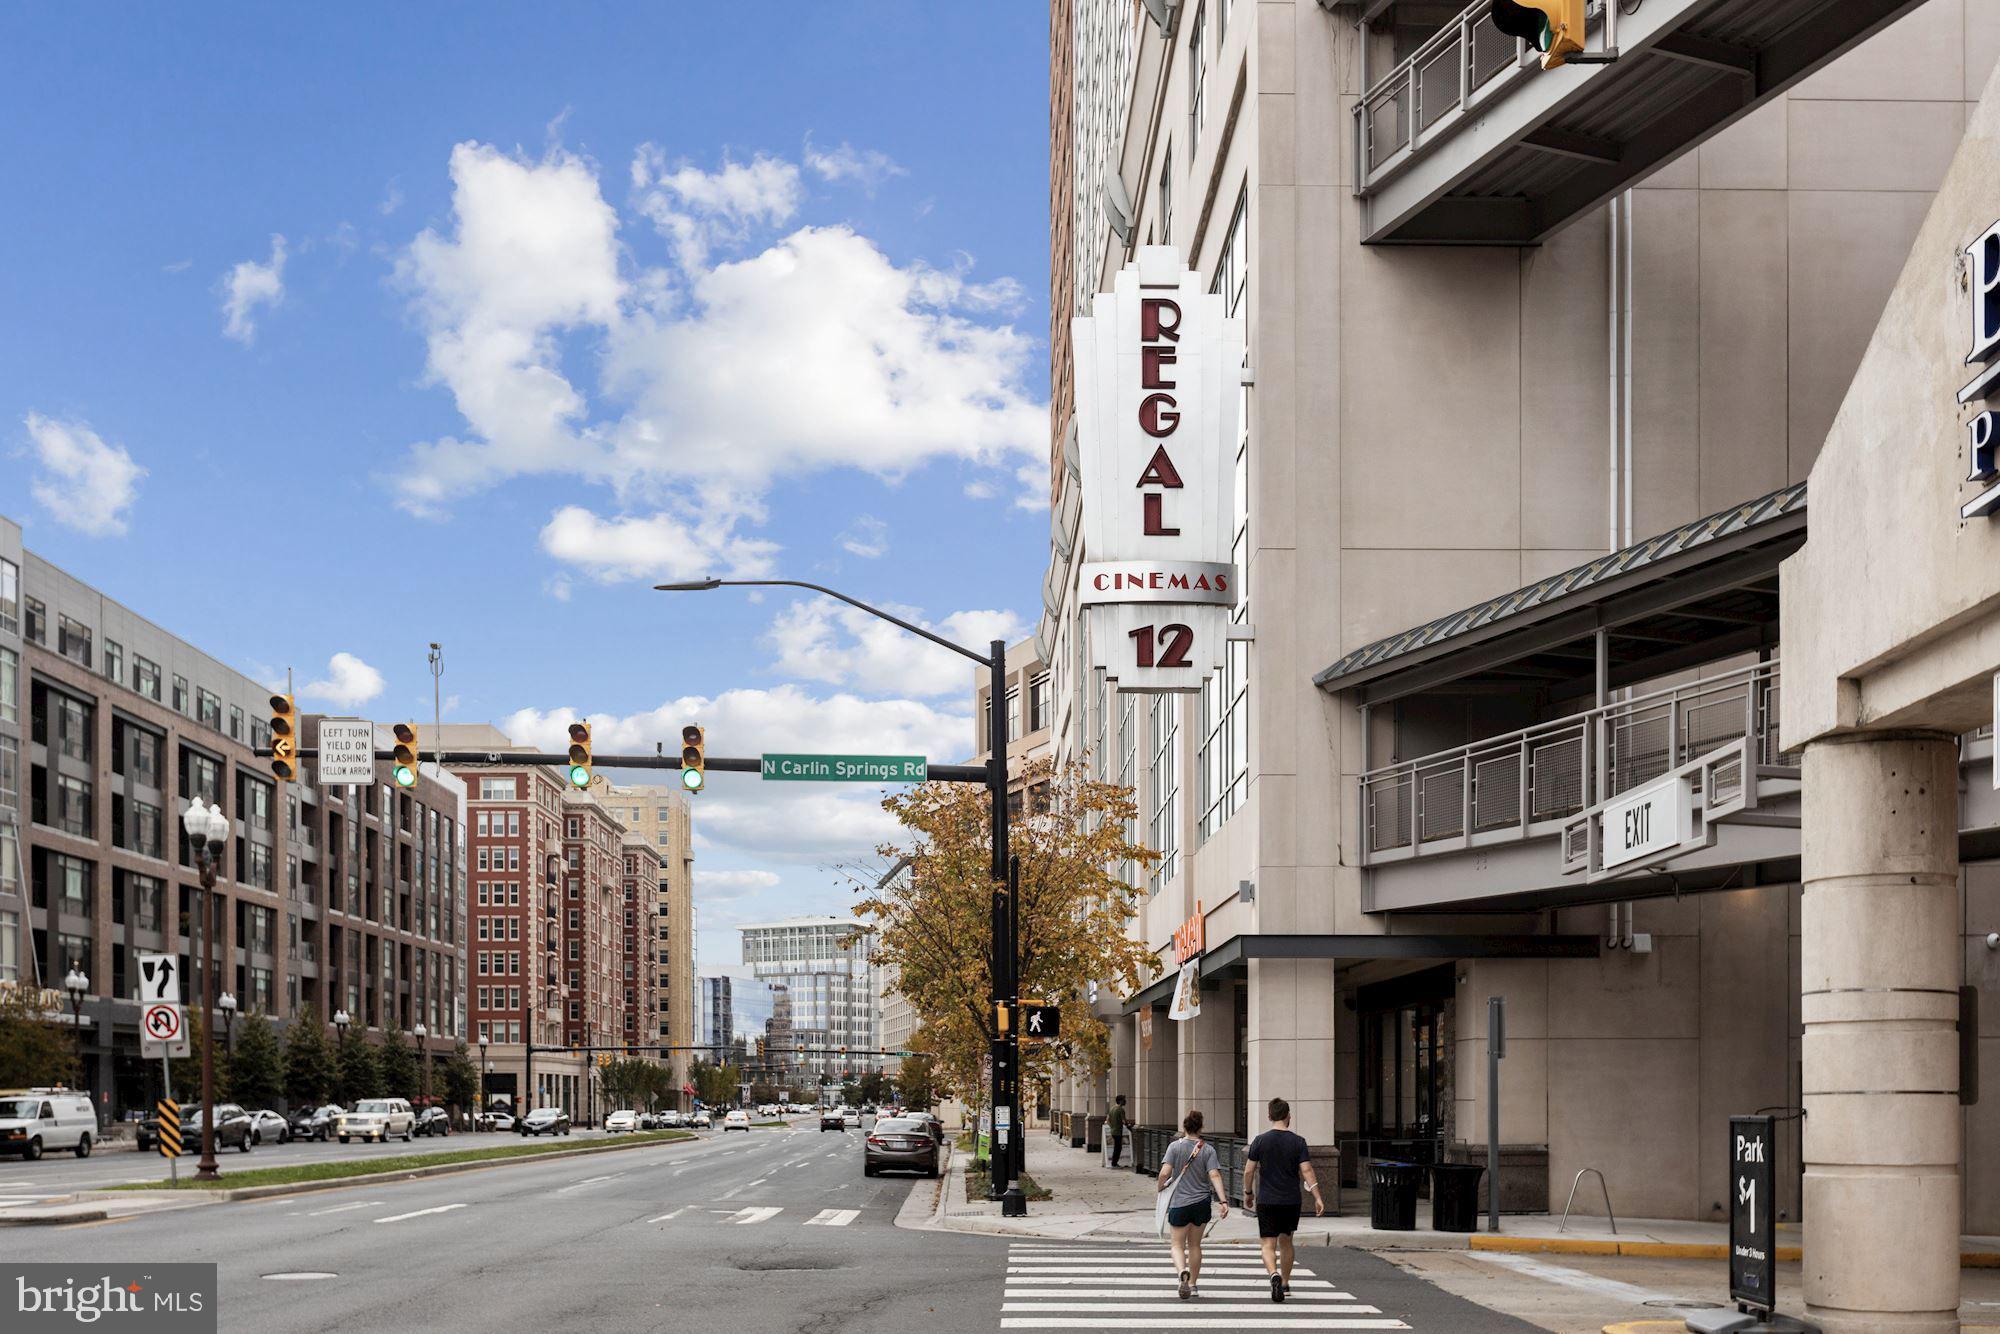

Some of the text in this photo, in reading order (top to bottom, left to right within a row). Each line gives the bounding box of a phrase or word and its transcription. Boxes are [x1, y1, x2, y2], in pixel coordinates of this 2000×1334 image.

[1136, 298, 1184, 536] REGAL
[1093, 572, 1228, 592] CINEMAS
[1128, 624, 1194, 668] 12
[323, 728, 370, 737] LEFT TURN
[326, 741, 367, 750] YIELD ON
[326, 754, 367, 763] FLASHING
[322, 766, 371, 776] YELLOW ARROW
[763, 760, 925, 780] N Carlin Springs Rd
[1625, 802, 1652, 850] EXIT
[1736, 1135, 1764, 1163] Park
[1739, 1175, 1756, 1234] $1
[1735, 1244, 1749, 1257] Under
[1753, 1247, 1766, 1260] Hours
